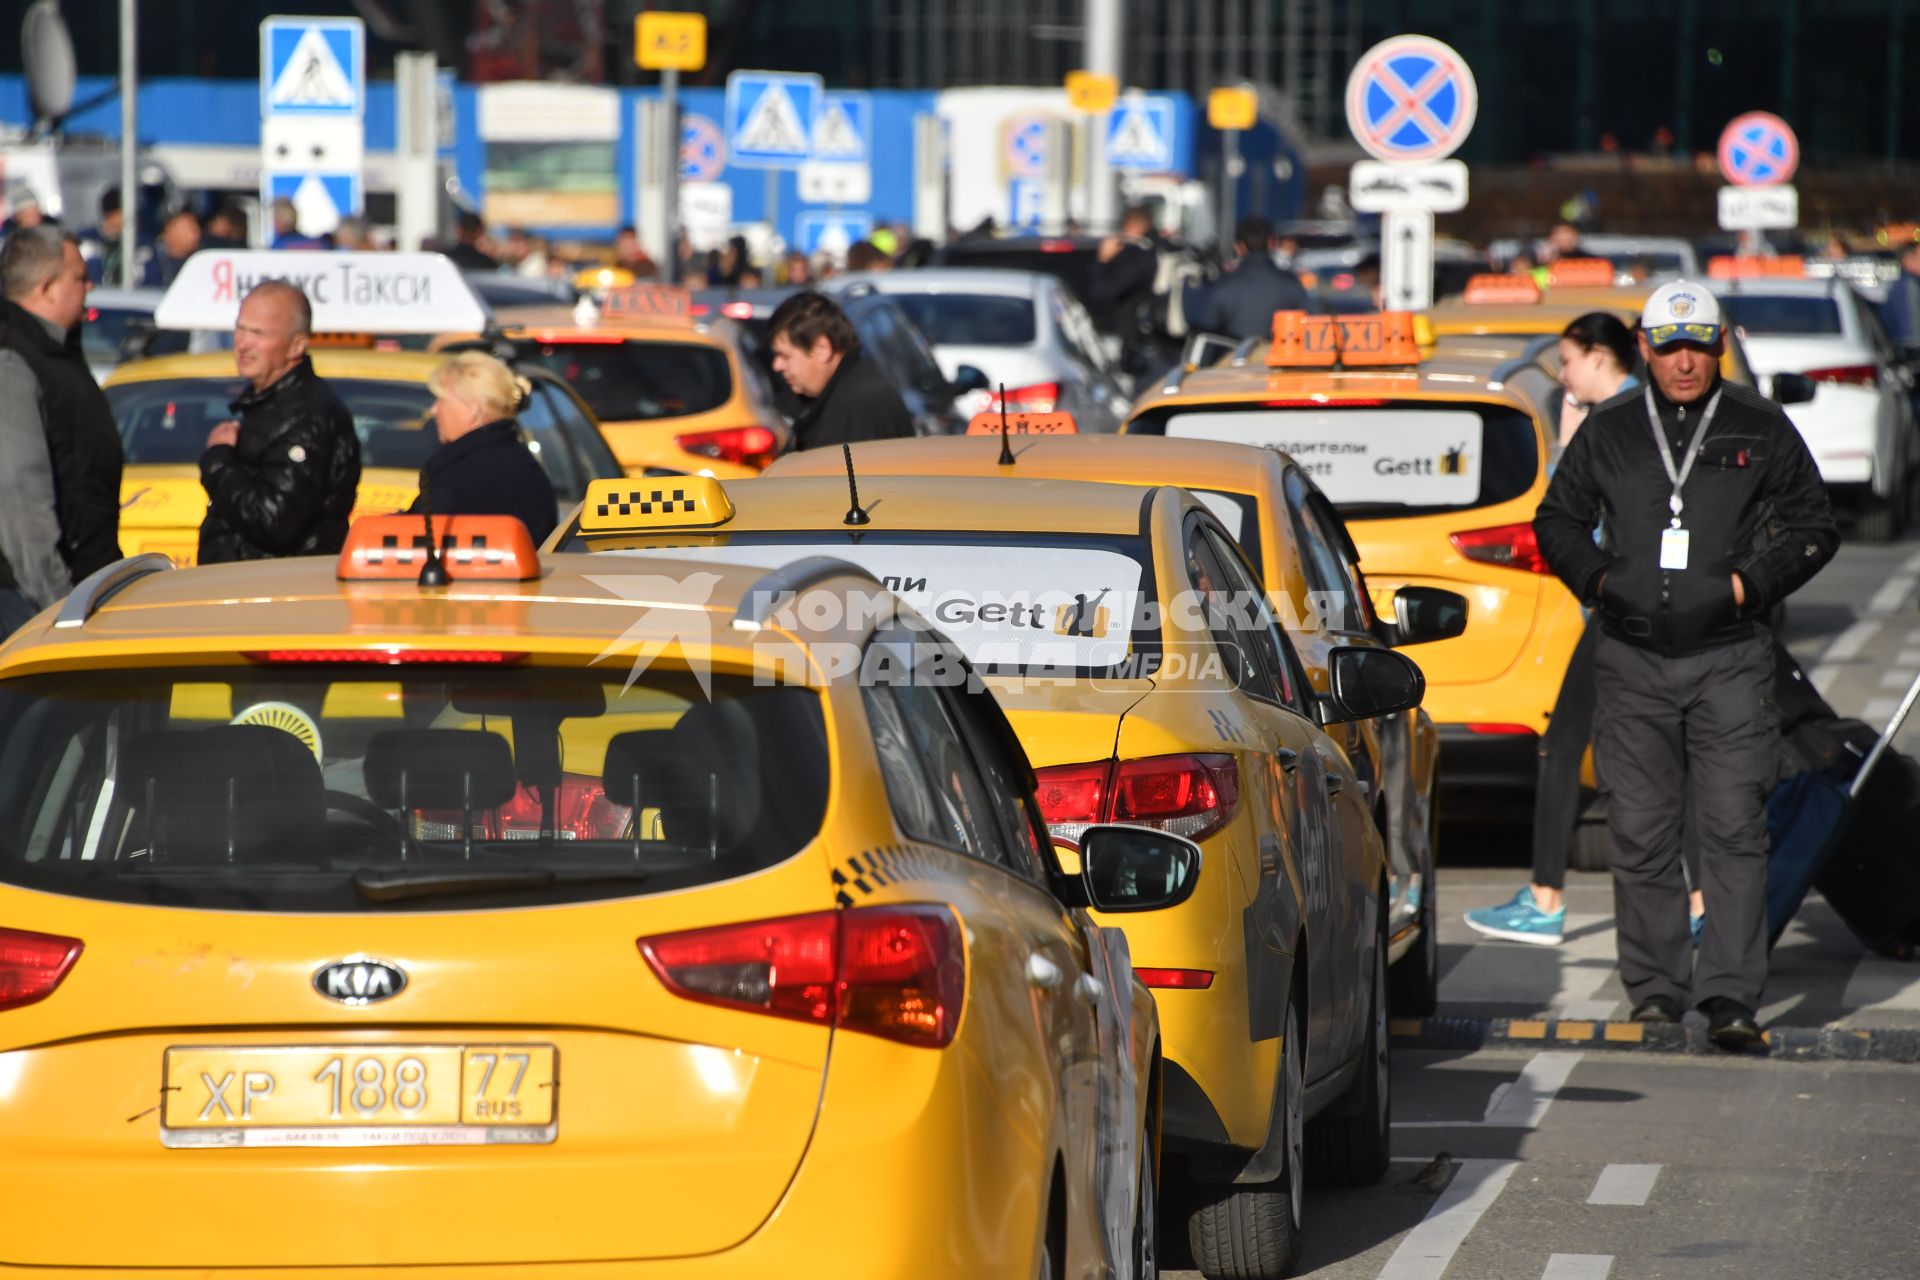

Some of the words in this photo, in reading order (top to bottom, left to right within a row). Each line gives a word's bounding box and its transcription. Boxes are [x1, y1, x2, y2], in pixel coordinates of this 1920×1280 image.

[336, 261, 431, 307] Такси
[1302, 321, 1383, 351] TAXI
[1303, 460, 1334, 476] ett
[1373, 457, 1433, 476] Gett
[935, 598, 1046, 630] Gett
[327, 965, 393, 996] KIA
[314, 1056, 427, 1119] 188
[470, 1052, 531, 1100] 77
[475, 1101, 522, 1118] RUS
